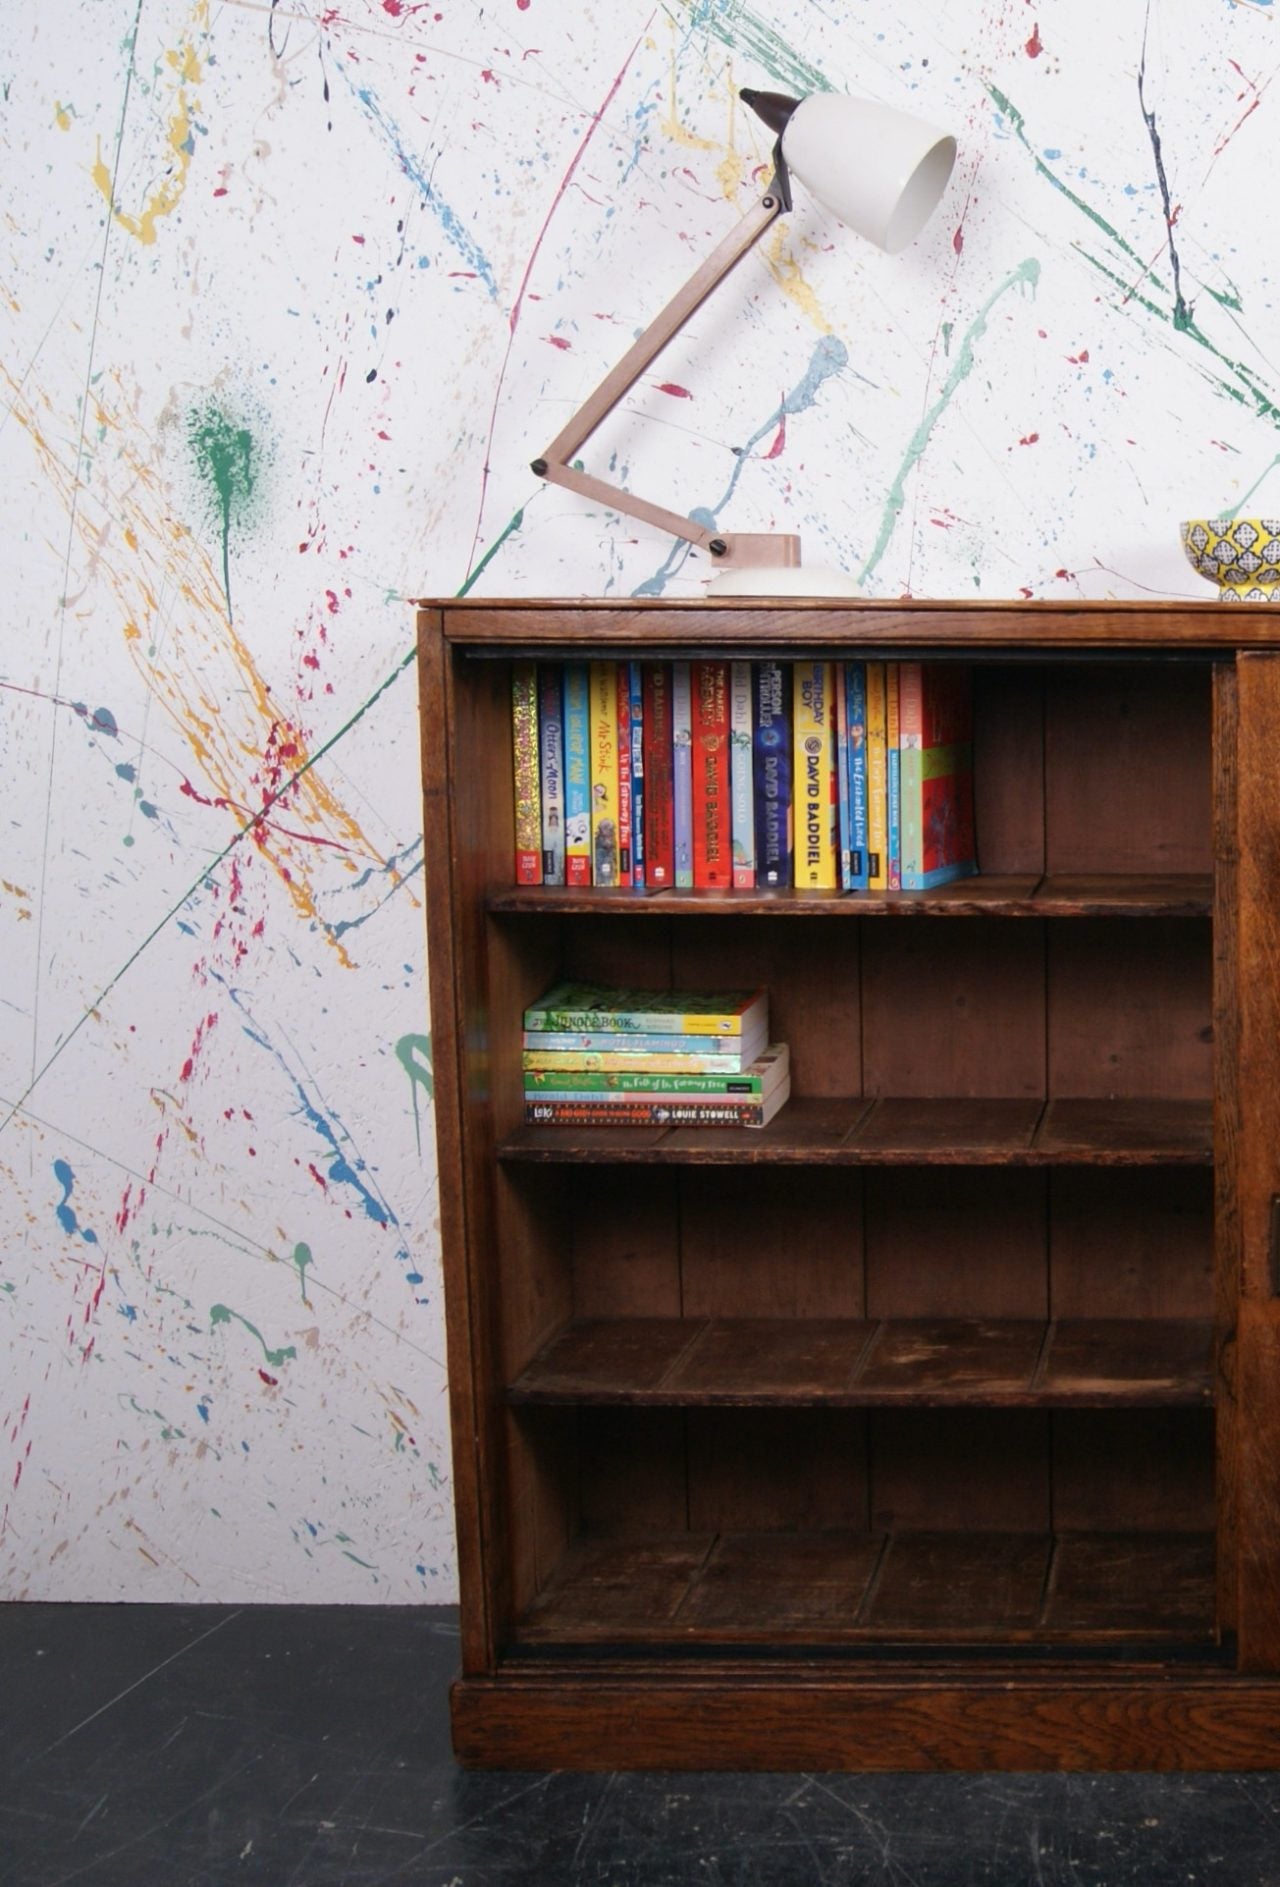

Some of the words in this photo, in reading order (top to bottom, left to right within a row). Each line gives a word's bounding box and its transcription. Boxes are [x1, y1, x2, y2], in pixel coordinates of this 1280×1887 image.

[771, 670, 782, 715] PERSON
[802, 681, 813, 709] BOY
[813, 664, 824, 726] BIRTHDAY
[598, 741, 612, 774] Stink
[765, 757, 779, 798] DAVID
[807, 756, 820, 797] DAVID
[546, 764, 560, 799] Moon
[766, 801, 780, 864] BADDIEL
[808, 803, 820, 866] BADDIEL
[671, 1109, 698, 1120] LOUIE
[700, 1109, 740, 1120] STOWELL
